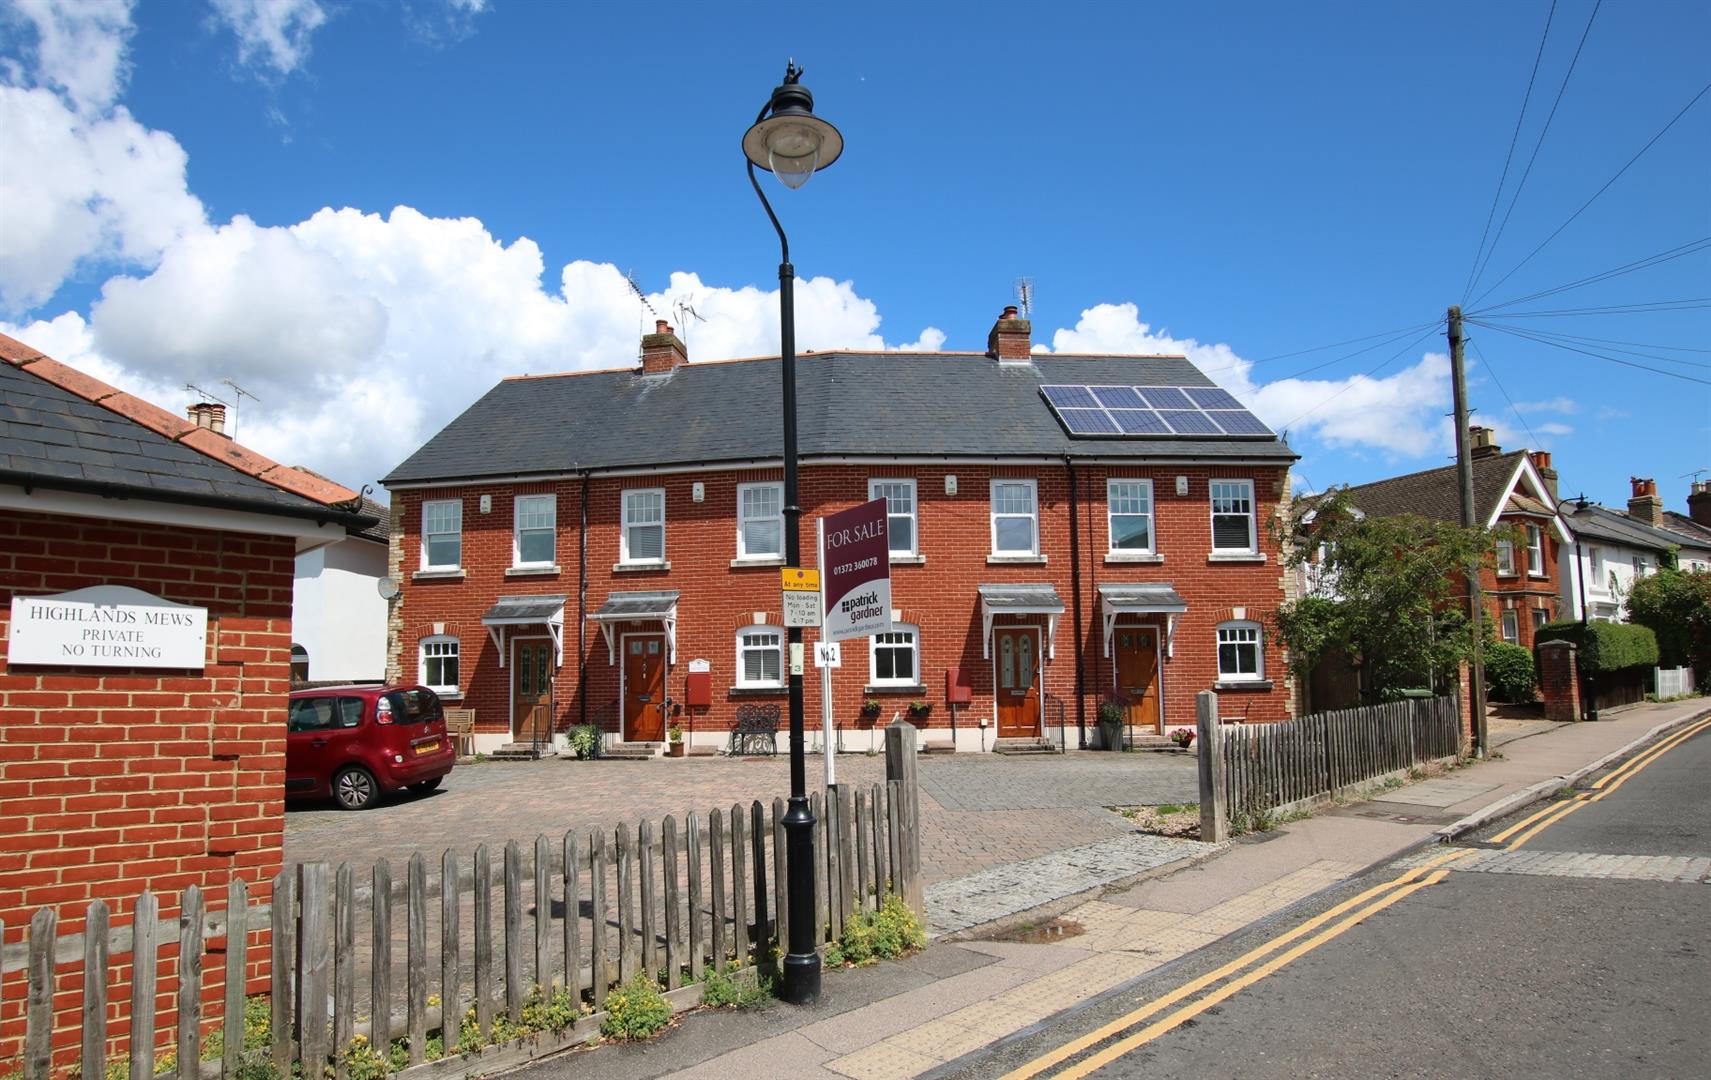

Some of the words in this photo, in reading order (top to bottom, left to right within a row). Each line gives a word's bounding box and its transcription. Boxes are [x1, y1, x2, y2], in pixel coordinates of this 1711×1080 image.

[827, 529, 852, 550] FOR
[854, 518, 884, 542] SALE
[833, 562, 853, 576] 01372
[853, 556, 878, 571] 360078
[796, 594, 818, 602] loading
[850, 591, 878, 611] patrick
[30, 606, 137, 624] HIGHLANDS
[144, 612, 193, 627] MEWS
[850, 605, 883, 624] gardner
[82, 628, 144, 642] PRIVATE
[62, 644, 84, 657] NO
[91, 645, 161, 658] TURNING
[820, 647, 836, 662] No.2
